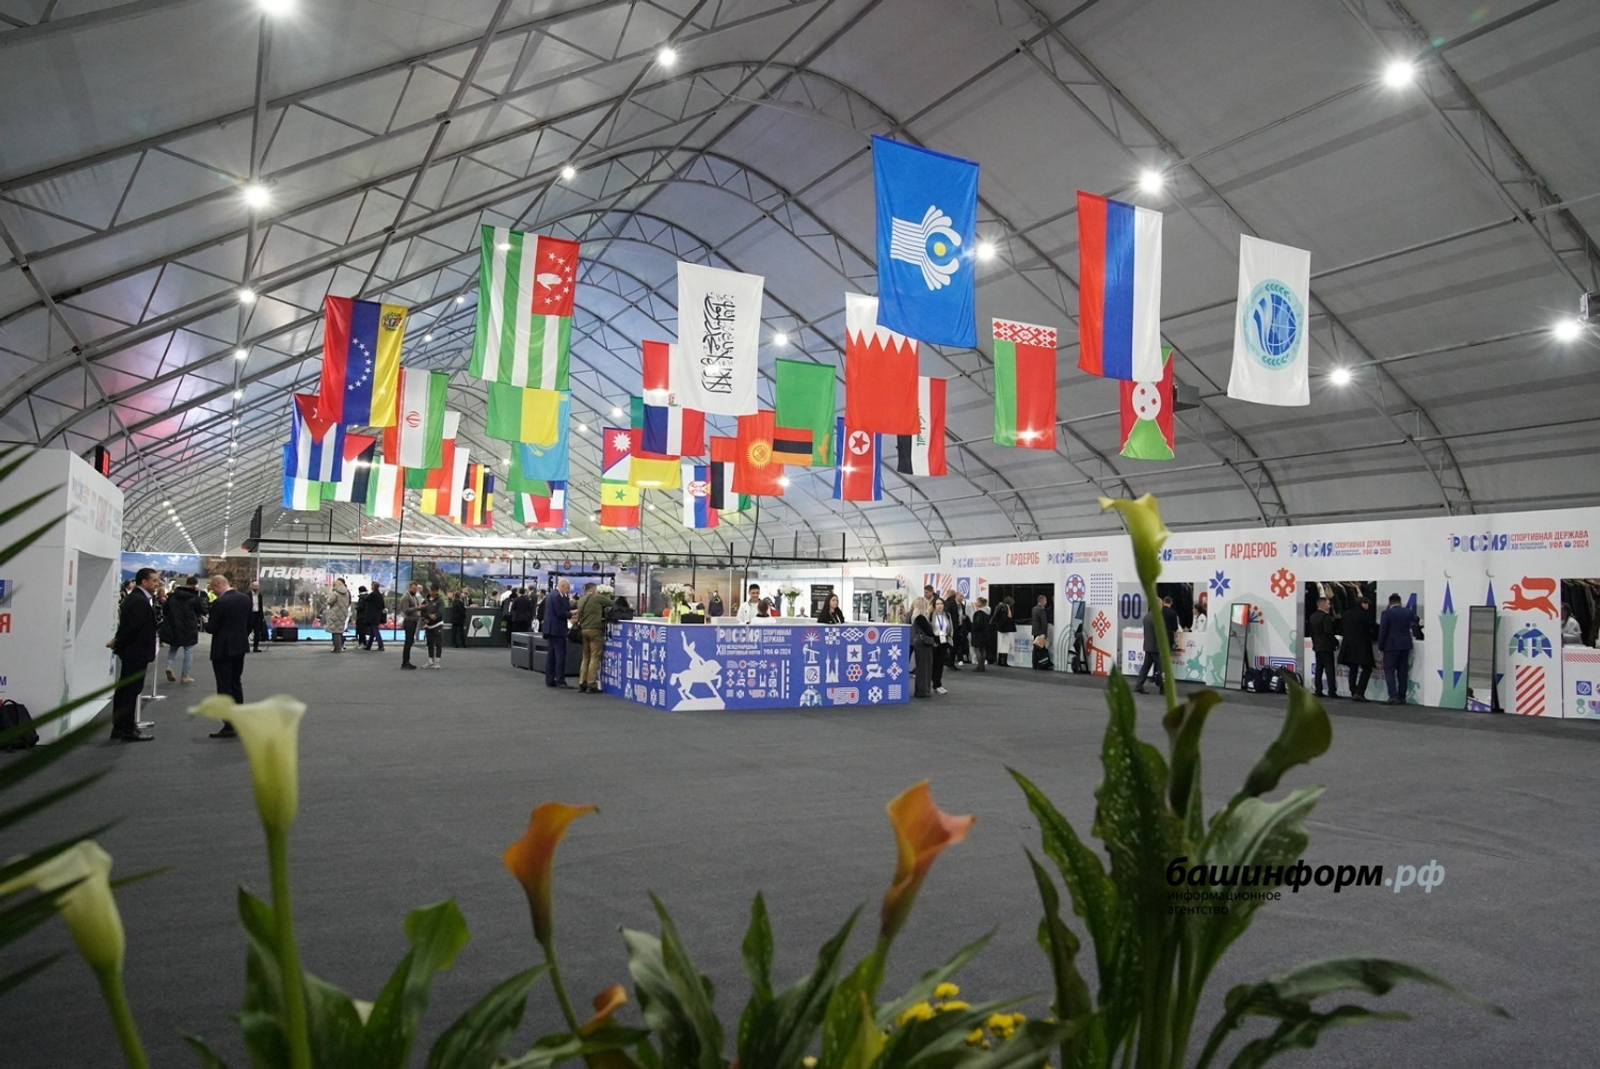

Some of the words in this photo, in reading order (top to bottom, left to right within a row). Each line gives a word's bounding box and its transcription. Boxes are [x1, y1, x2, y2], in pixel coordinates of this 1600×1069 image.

[1450, 532, 1508, 552] РОССИЯ
[1511, 532, 1553, 542] СПОРТИВНАЯ
[1554, 530, 1589, 540] ДЕРЖАВА
[1224, 542, 1277, 560] ГАРДЕРОБ
[1290, 541, 1333, 557] РОССИЯ
[1572, 540, 1589, 548] 2024
[1006, 552, 1040, 566] ГАРДЕРОБ
[716, 628, 761, 643] РОССИЯ
